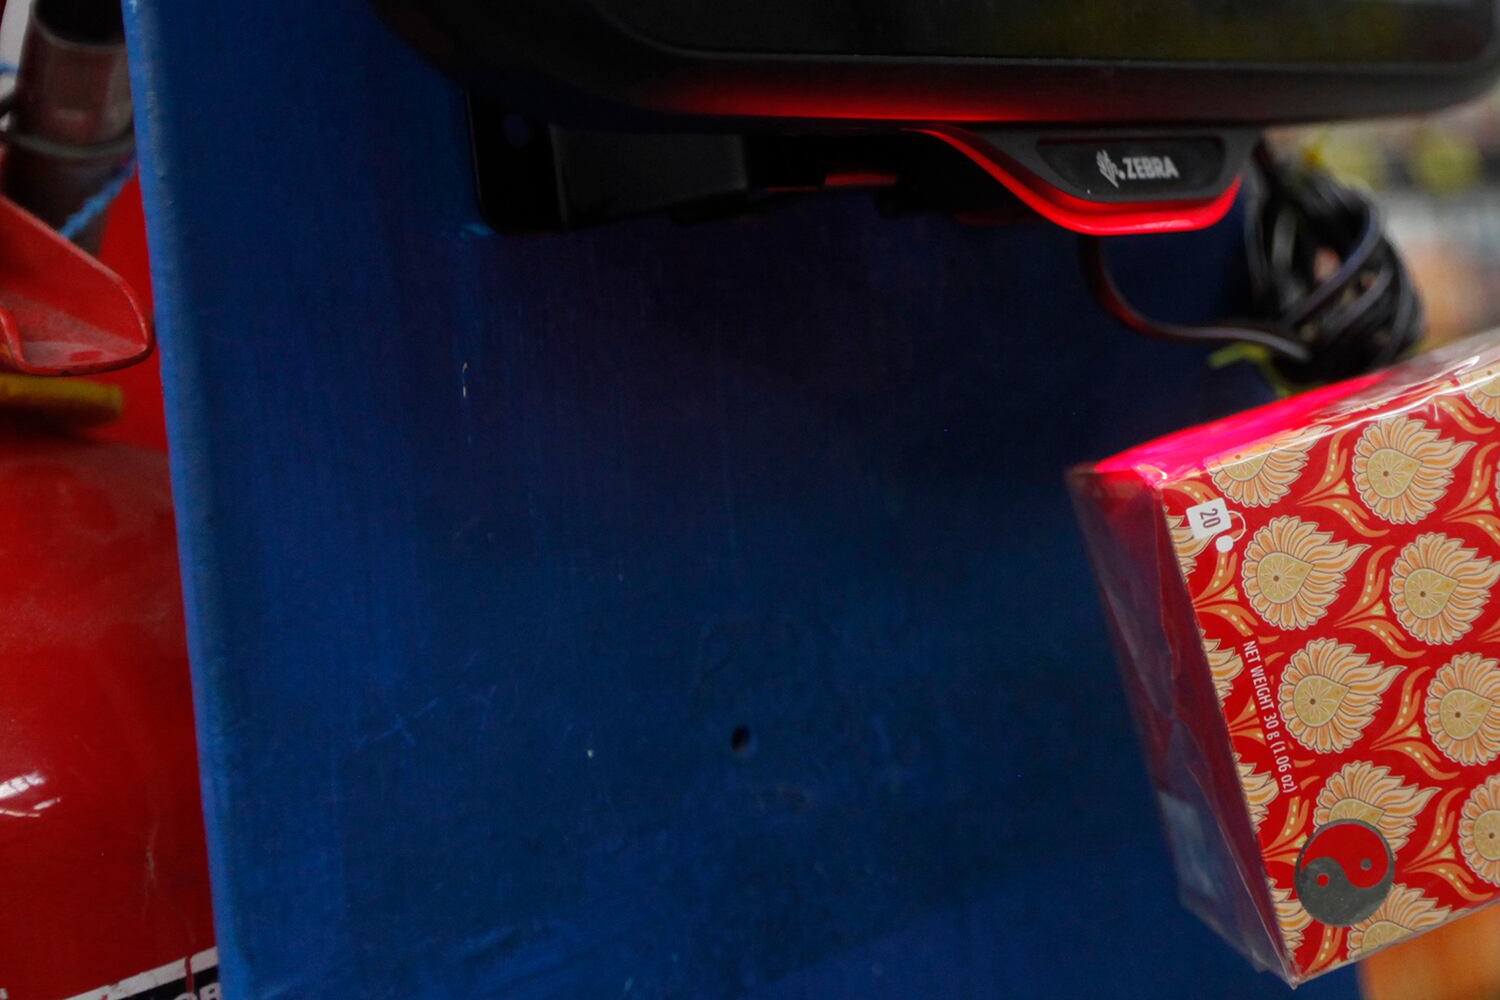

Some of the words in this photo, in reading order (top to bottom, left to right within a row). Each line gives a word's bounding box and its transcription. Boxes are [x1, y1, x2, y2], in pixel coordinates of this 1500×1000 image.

[1122, 155, 1179, 180] ZEBRA
[1200, 508, 1221, 529] 20
[1243, 640, 1261, 663] NET
[1250, 665, 1275, 710] WEIGHT
[1264, 712, 1280, 729] 30
[1266, 731, 1280, 740] g
[1270, 741, 1292, 773] (1.06
[1281, 774, 1298, 793] oz)
